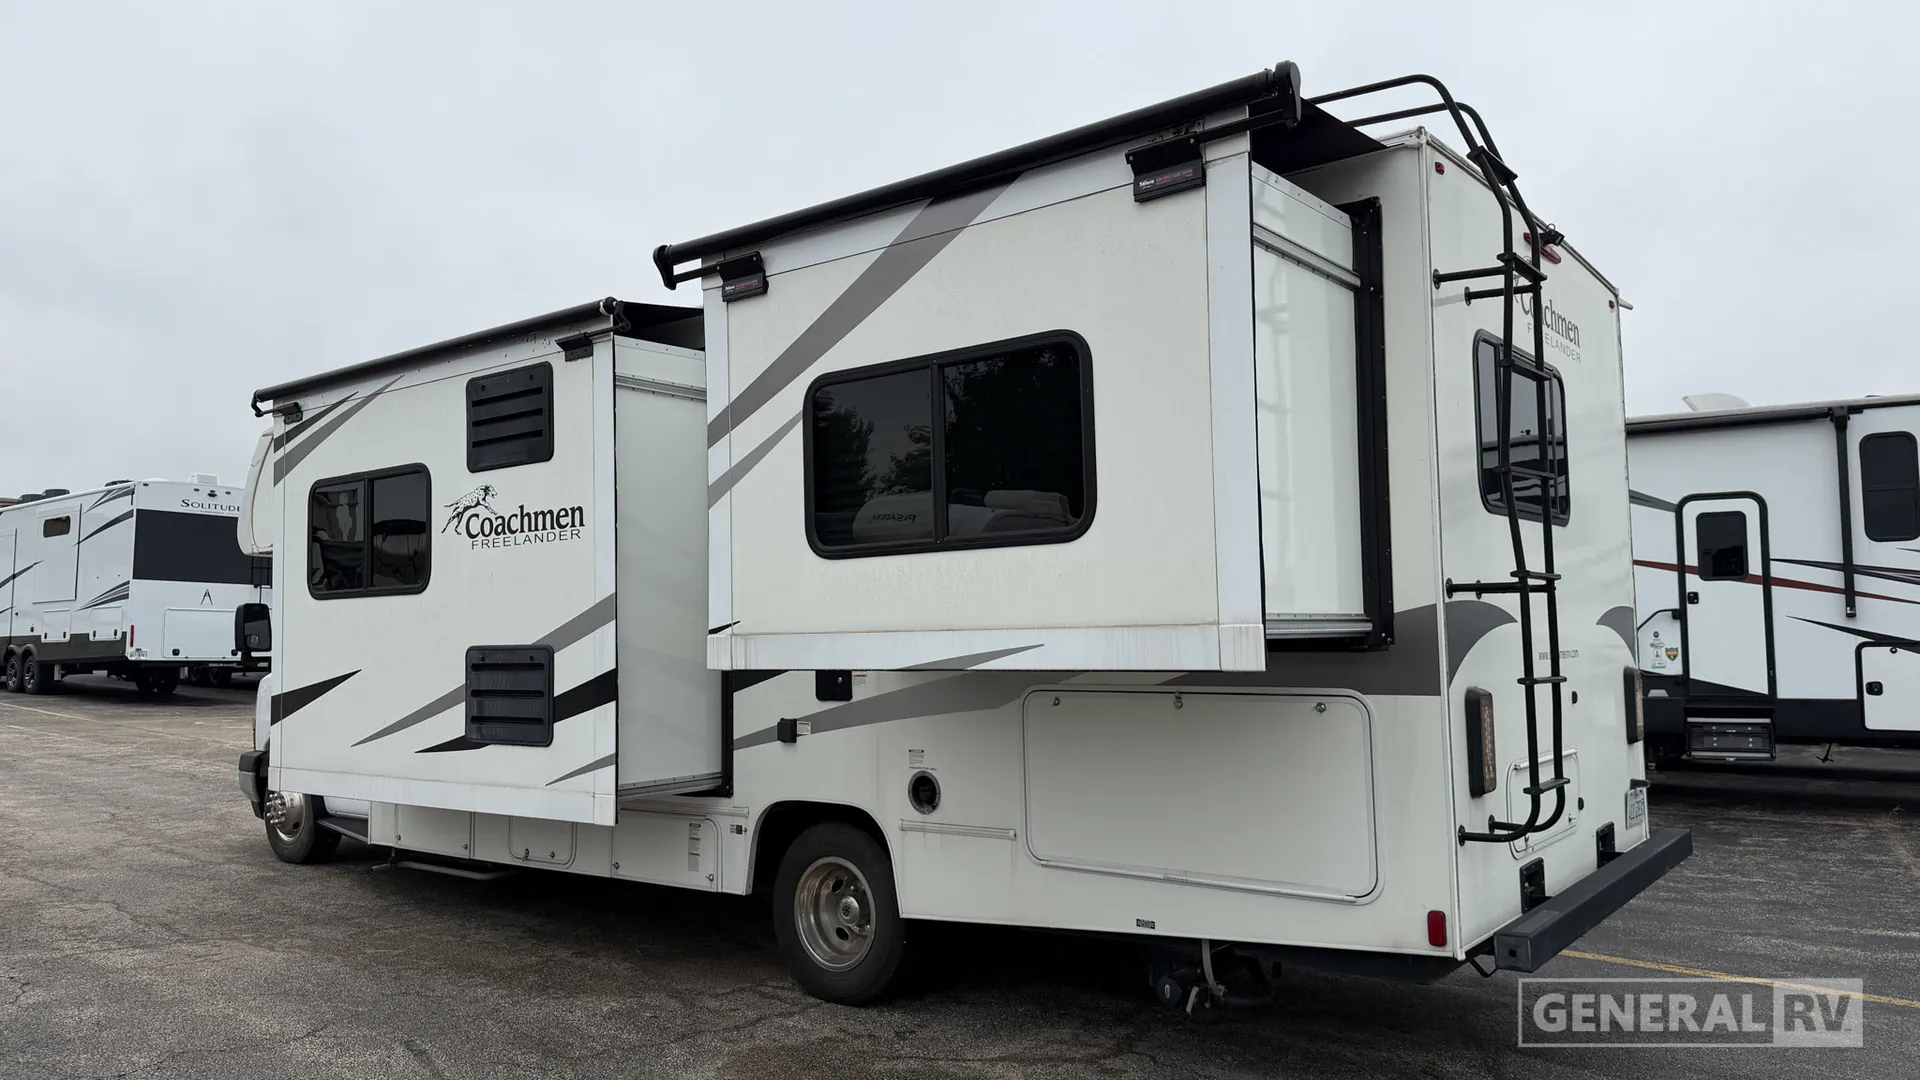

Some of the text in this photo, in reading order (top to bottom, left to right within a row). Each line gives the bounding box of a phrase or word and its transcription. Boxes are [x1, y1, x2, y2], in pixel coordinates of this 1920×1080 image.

[1520, 291, 1581, 348] Cochmen
[1527, 322, 1582, 365] FELANDER
[465, 504, 586, 540] Coachmen
[471, 528, 582, 550] FREELANDER
